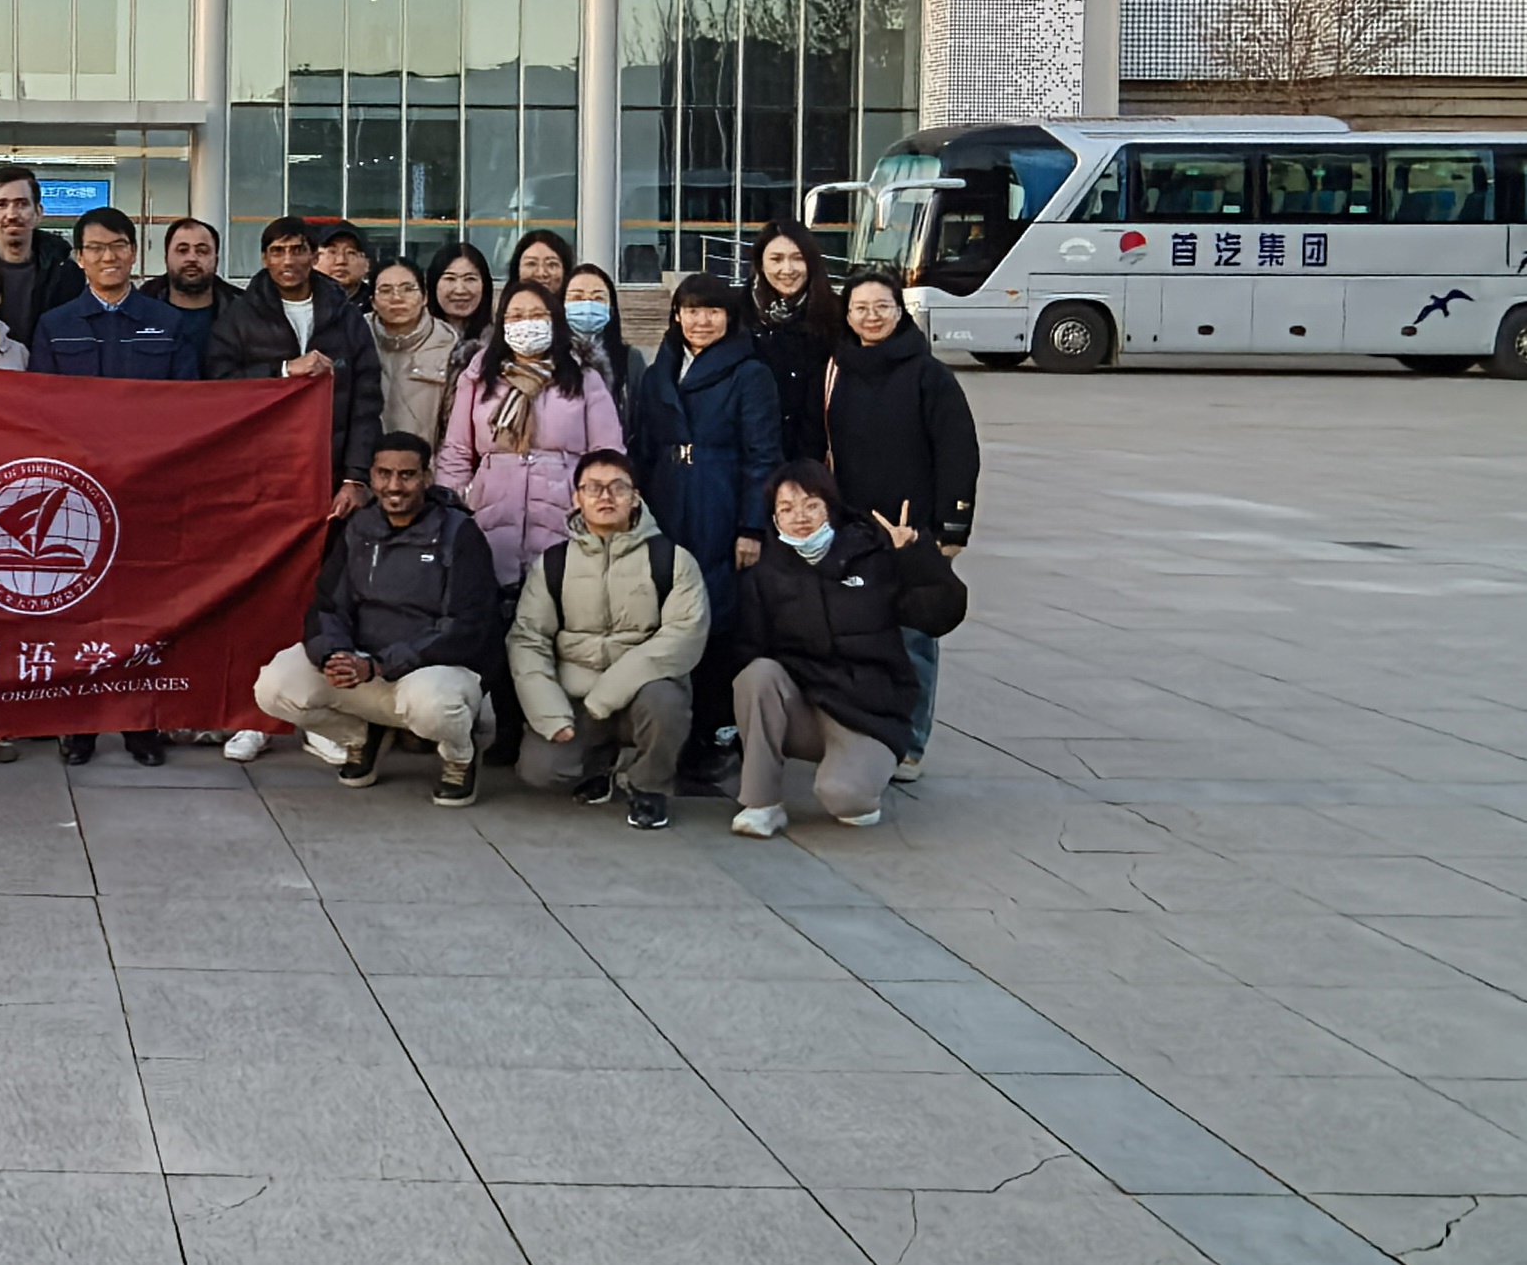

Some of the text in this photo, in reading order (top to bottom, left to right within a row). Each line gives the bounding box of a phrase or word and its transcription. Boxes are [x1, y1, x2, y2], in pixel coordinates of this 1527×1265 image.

[1171, 231, 1328, 267] 首汽集团
[77, 677, 190, 695] LANGUAGES
